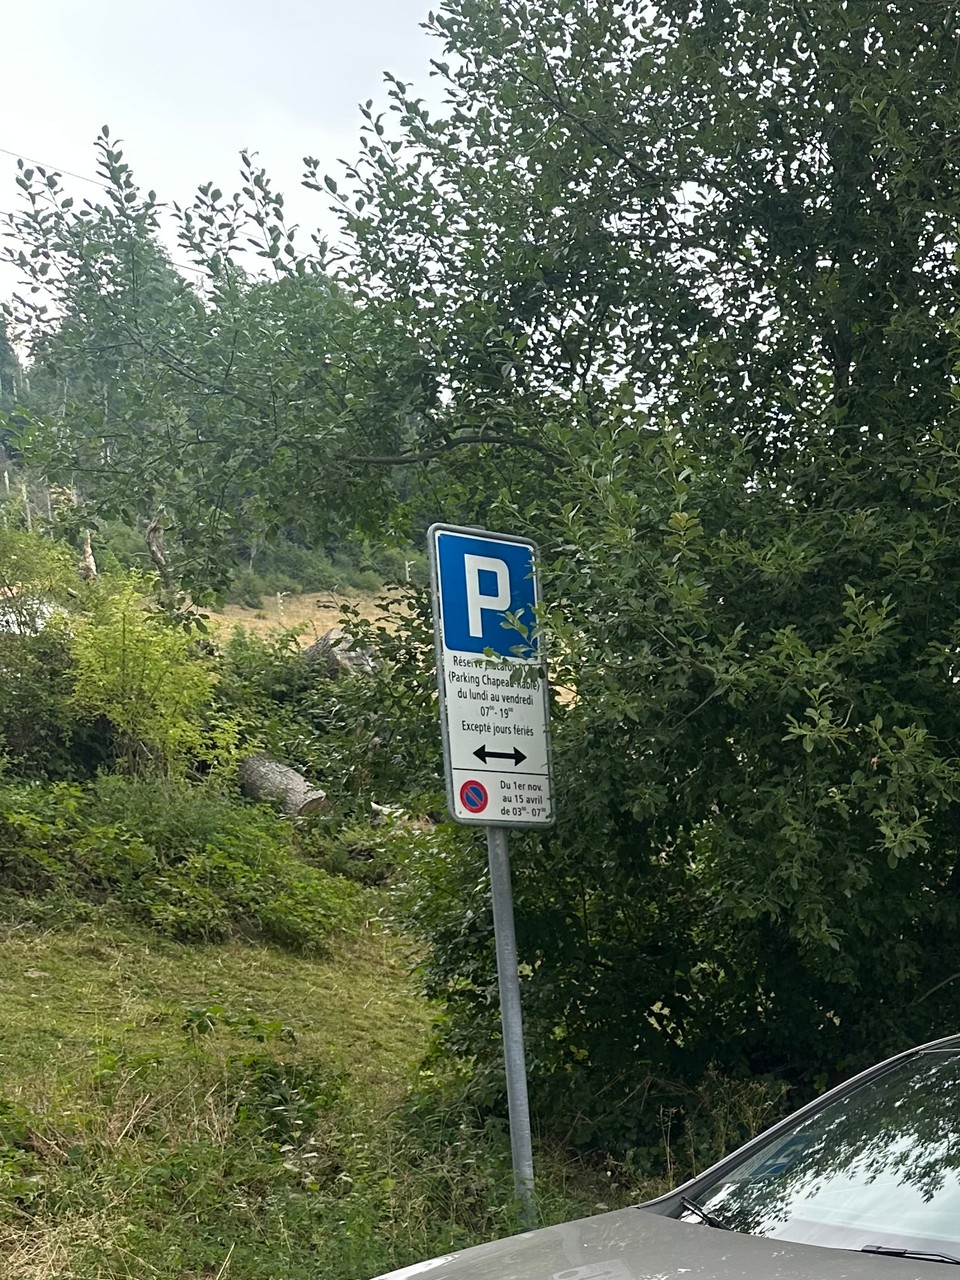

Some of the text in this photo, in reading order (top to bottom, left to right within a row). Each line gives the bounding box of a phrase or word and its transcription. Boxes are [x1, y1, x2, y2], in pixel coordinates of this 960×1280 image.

[464, 553, 512, 638] P
[448, 670, 480, 687] (Parking
[457, 688, 534, 706] du lundi au vendredi
[461, 720, 534, 737] Excepté jours fériés
[500, 780, 543, 792] Du 1er nov.
[502, 794, 543, 805] au 15 avril
[500, 806, 511, 816] de
